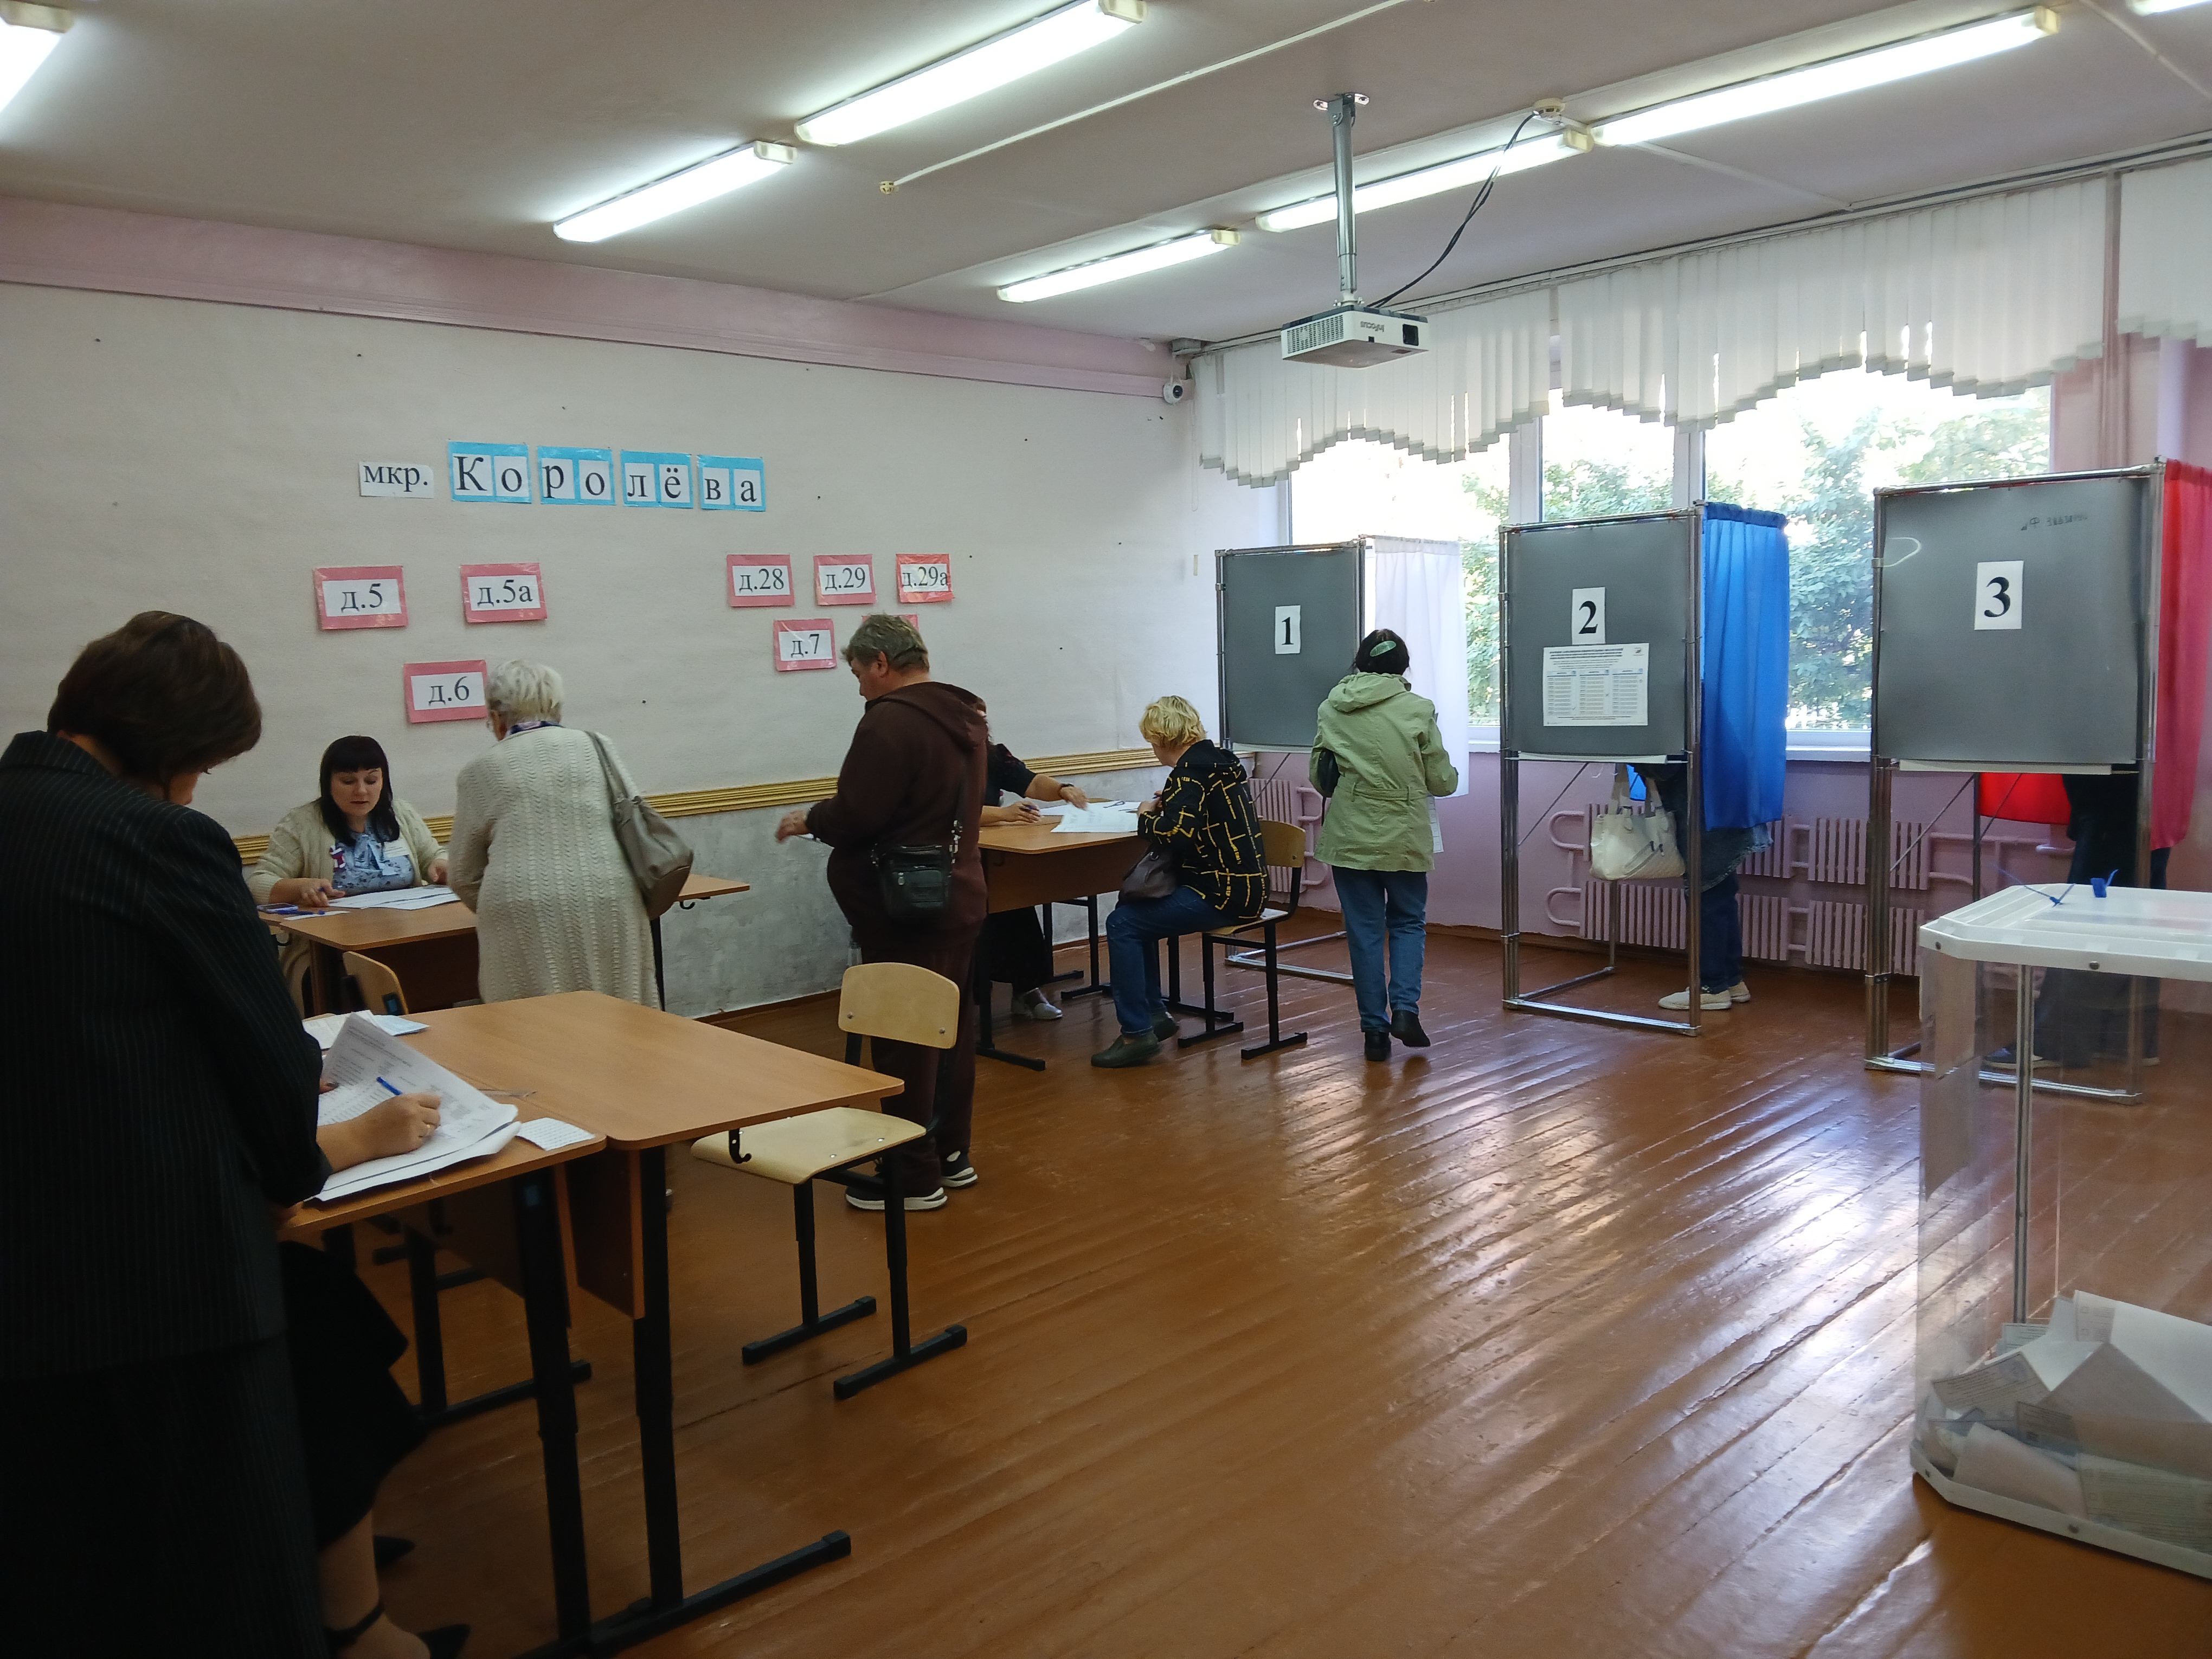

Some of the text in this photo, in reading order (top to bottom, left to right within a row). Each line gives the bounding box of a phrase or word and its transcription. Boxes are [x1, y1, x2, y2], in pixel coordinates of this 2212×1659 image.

[364, 456, 757, 503] мкр. Королёва
[739, 568, 785, 593] д.28
[825, 567, 866, 592] д.29
[902, 566, 949, 588] д.29а
[340, 583, 383, 614] д.5
[477, 580, 533, 607] д.5а
[1984, 576, 2010, 618] 3
[1281, 616, 1294, 645] 1
[1578, 600, 1598, 634] 2
[790, 633, 820, 658] д.7
[428, 676, 470, 706] д.6
